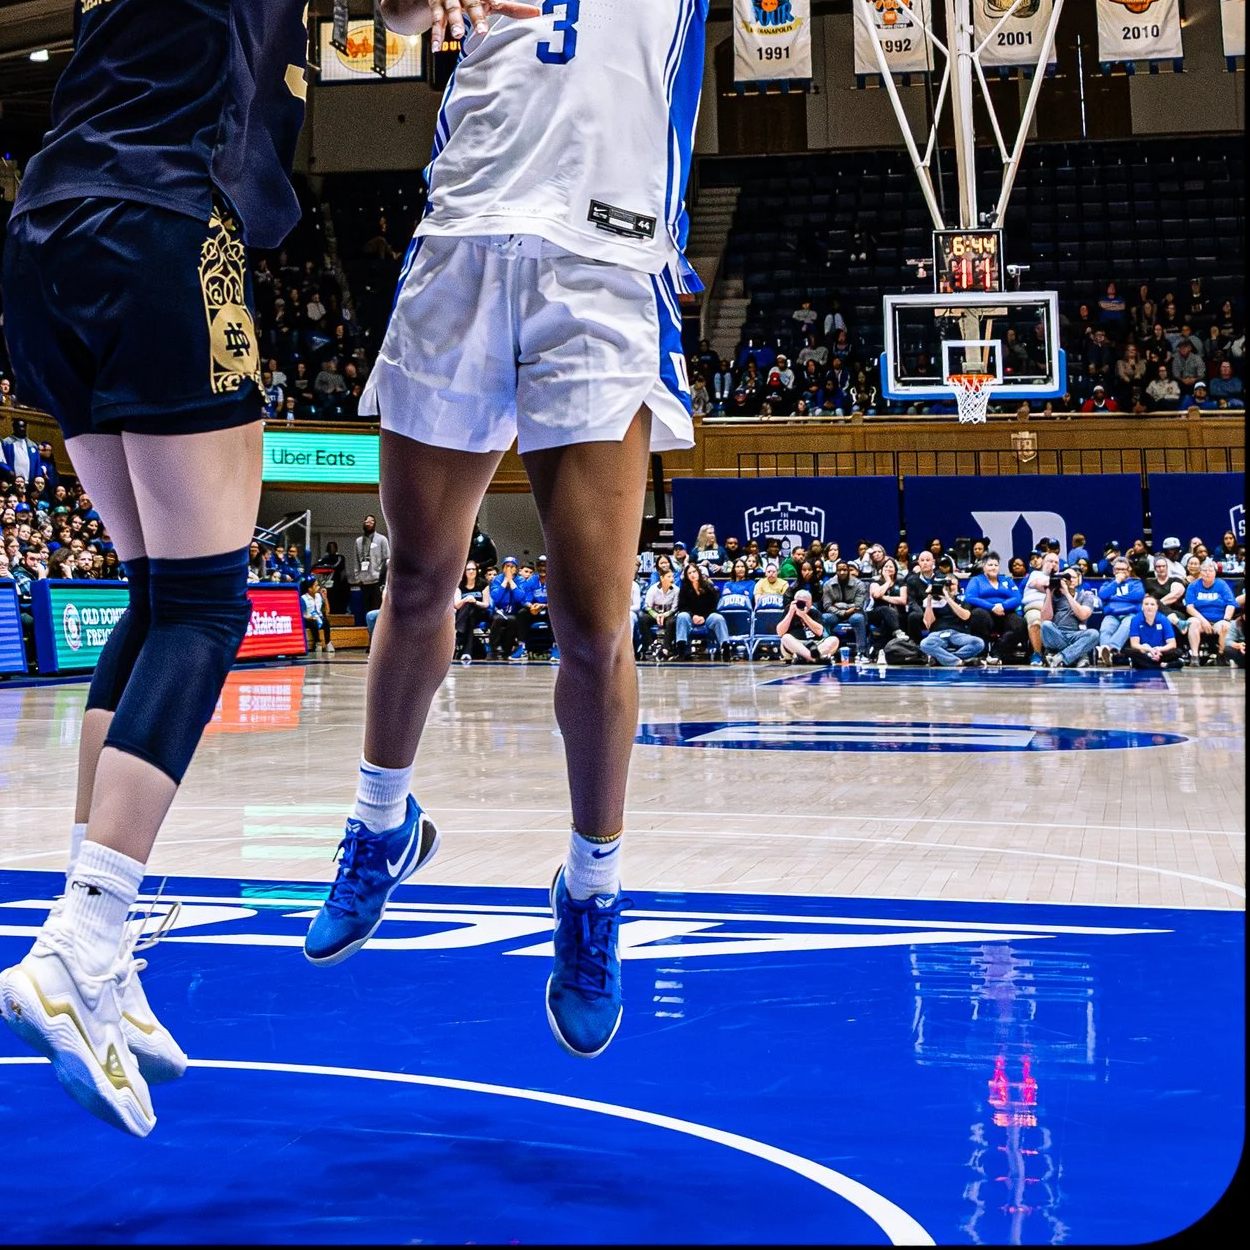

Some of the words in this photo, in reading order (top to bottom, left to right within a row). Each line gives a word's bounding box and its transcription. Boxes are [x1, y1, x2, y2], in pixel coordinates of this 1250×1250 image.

[997, 31, 1033, 46] 2001
[1122, 24, 1160, 40] 2010
[756, 46, 790, 60] 1991
[953, 236, 994, 256] 6:44
[272, 449, 312, 465] Uber
[315, 450, 356, 466] Eats
[752, 519, 819, 538] SISTERHOOD
[81, 608, 100, 625] OLD
